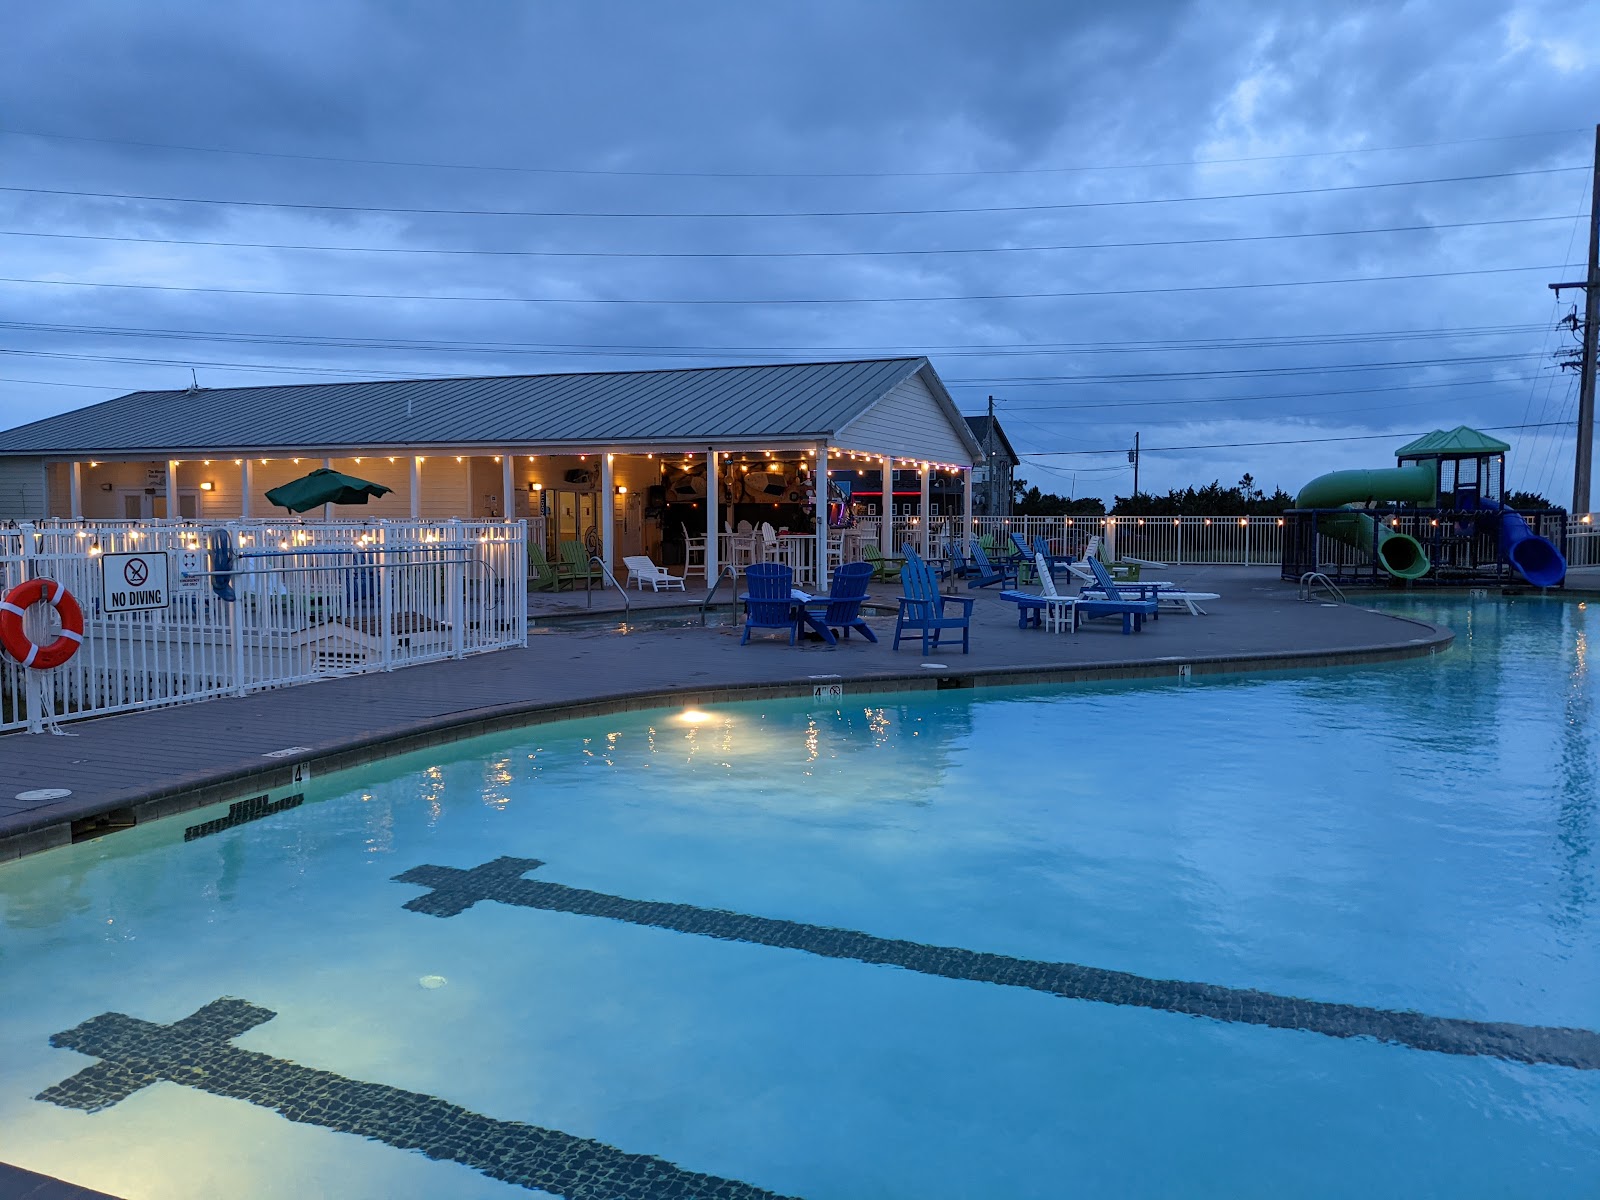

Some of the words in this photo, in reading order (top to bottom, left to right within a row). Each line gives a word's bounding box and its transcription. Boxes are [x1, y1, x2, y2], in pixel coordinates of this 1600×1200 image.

[112, 592, 126, 607] NO
[130, 590, 162, 606] DIVING
[295, 764, 302, 781] 4
